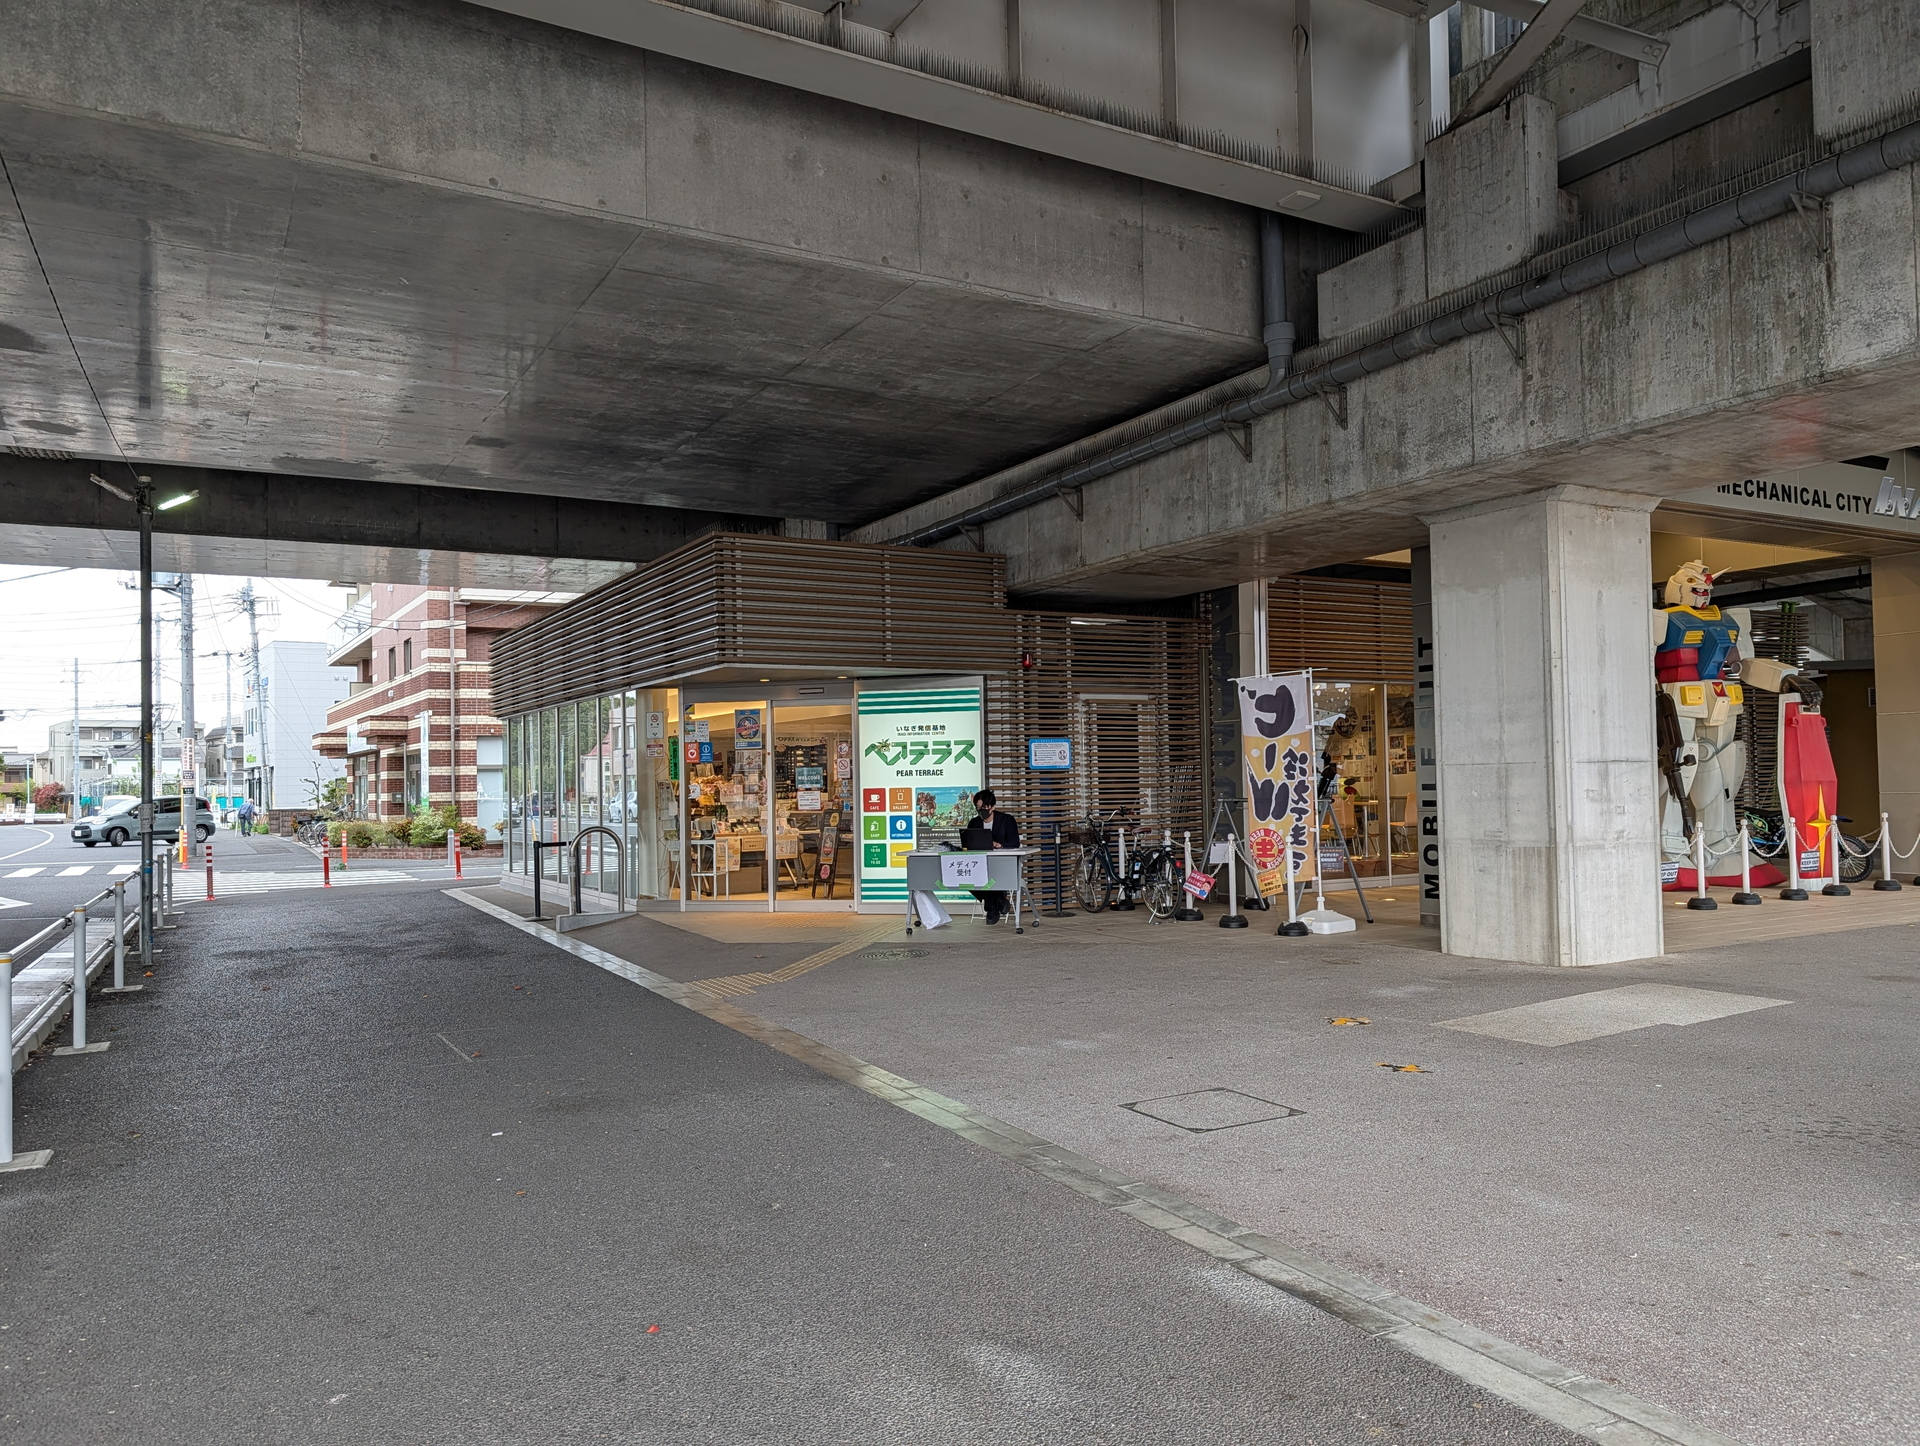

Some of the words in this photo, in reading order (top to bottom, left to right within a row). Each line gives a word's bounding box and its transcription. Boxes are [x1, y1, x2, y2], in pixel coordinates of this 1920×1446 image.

[1836, 493, 1872, 514] CITY
[896, 769, 913, 777] PEAR
[1421, 748, 1440, 899] MOBILE
[949, 861, 978, 869] メディア
[956, 869, 971, 877] 受付
